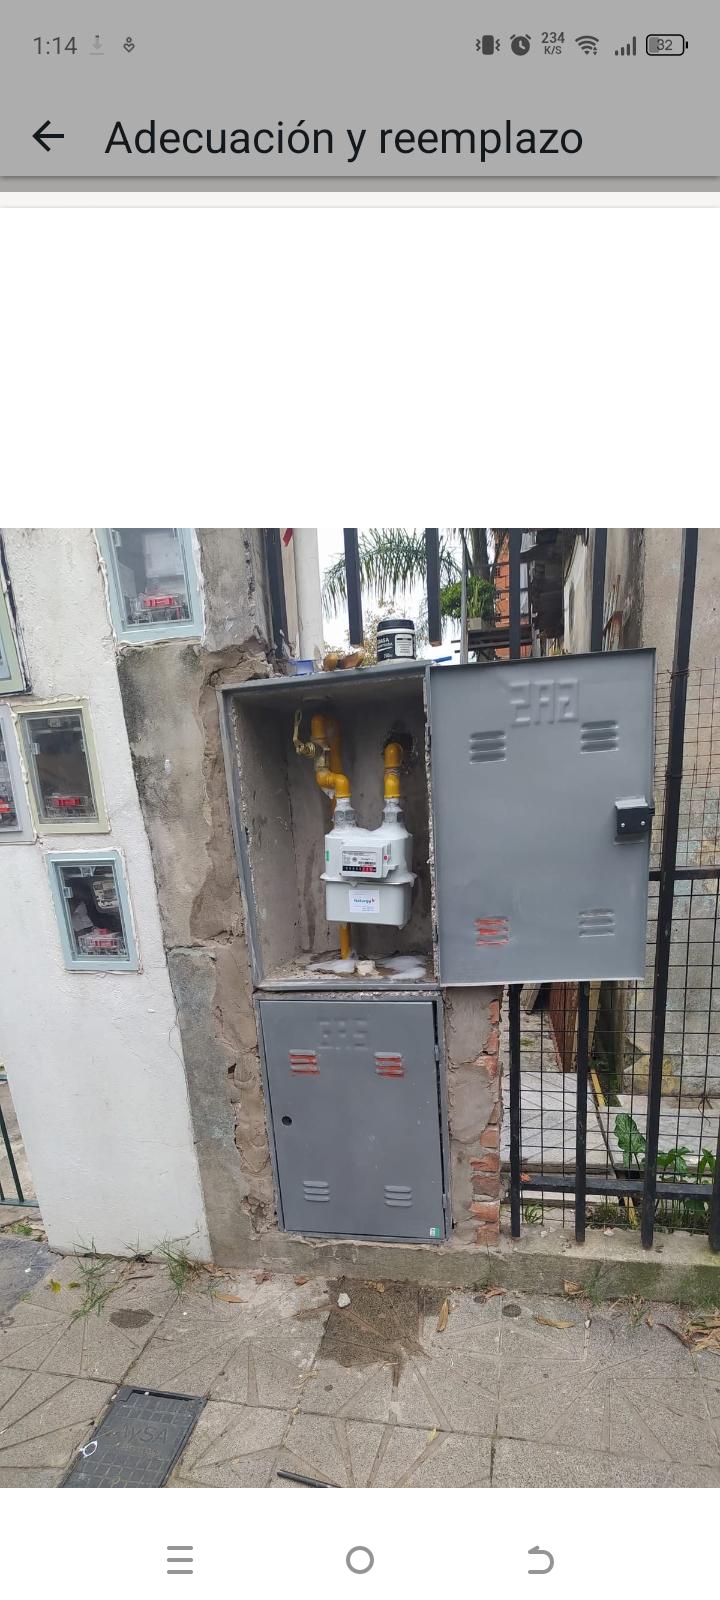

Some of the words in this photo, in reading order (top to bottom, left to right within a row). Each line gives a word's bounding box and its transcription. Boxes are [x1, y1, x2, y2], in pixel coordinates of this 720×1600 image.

[541, 31, 566, 44] 234
[33, 36, 78, 55] 1:14
[544, 45, 562, 56] K/S
[656, 38, 673, 51] 32
[104, 119, 334, 154] Adecuación
[346, 129, 367, 163] y
[380, 119, 583, 163] reemplazo
